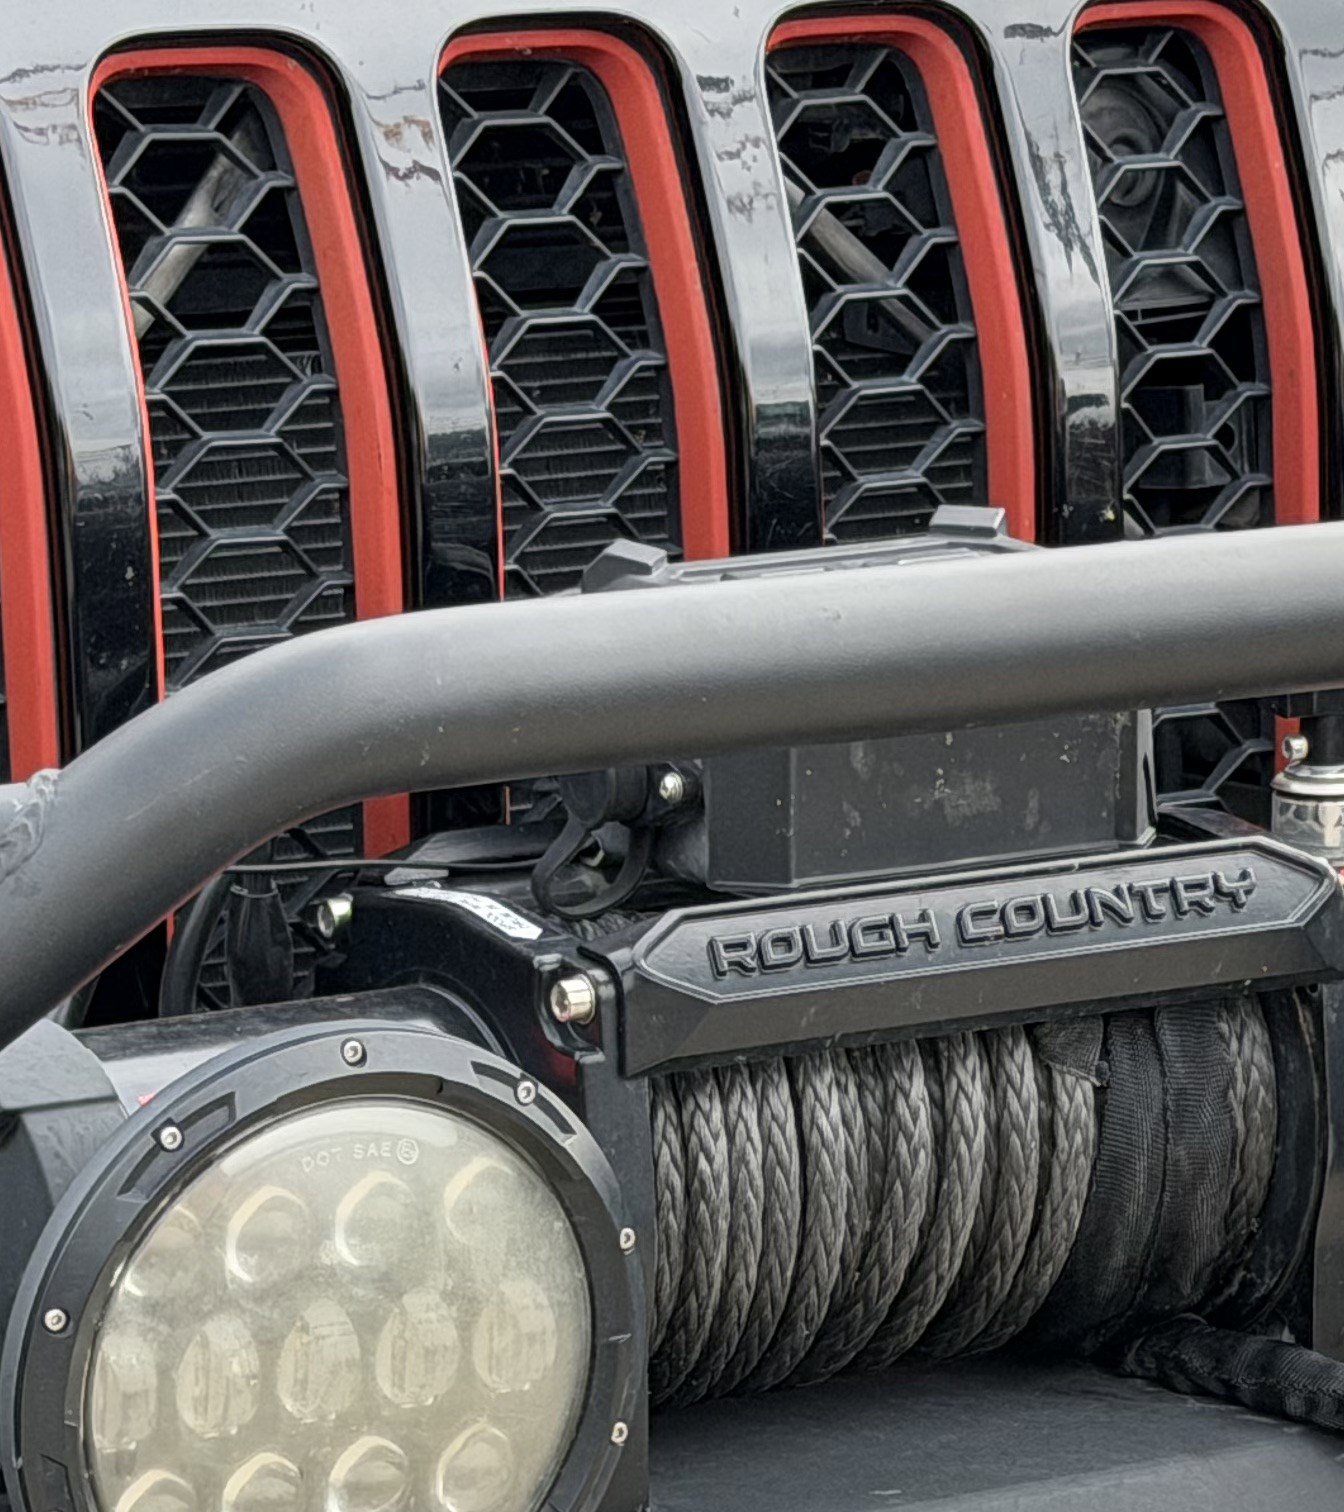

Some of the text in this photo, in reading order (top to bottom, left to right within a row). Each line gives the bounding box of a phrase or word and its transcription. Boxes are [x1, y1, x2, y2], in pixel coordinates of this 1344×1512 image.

[707, 867, 1259, 981] ROUGH COUNTRY
[353, 1140, 393, 1160] SAE
